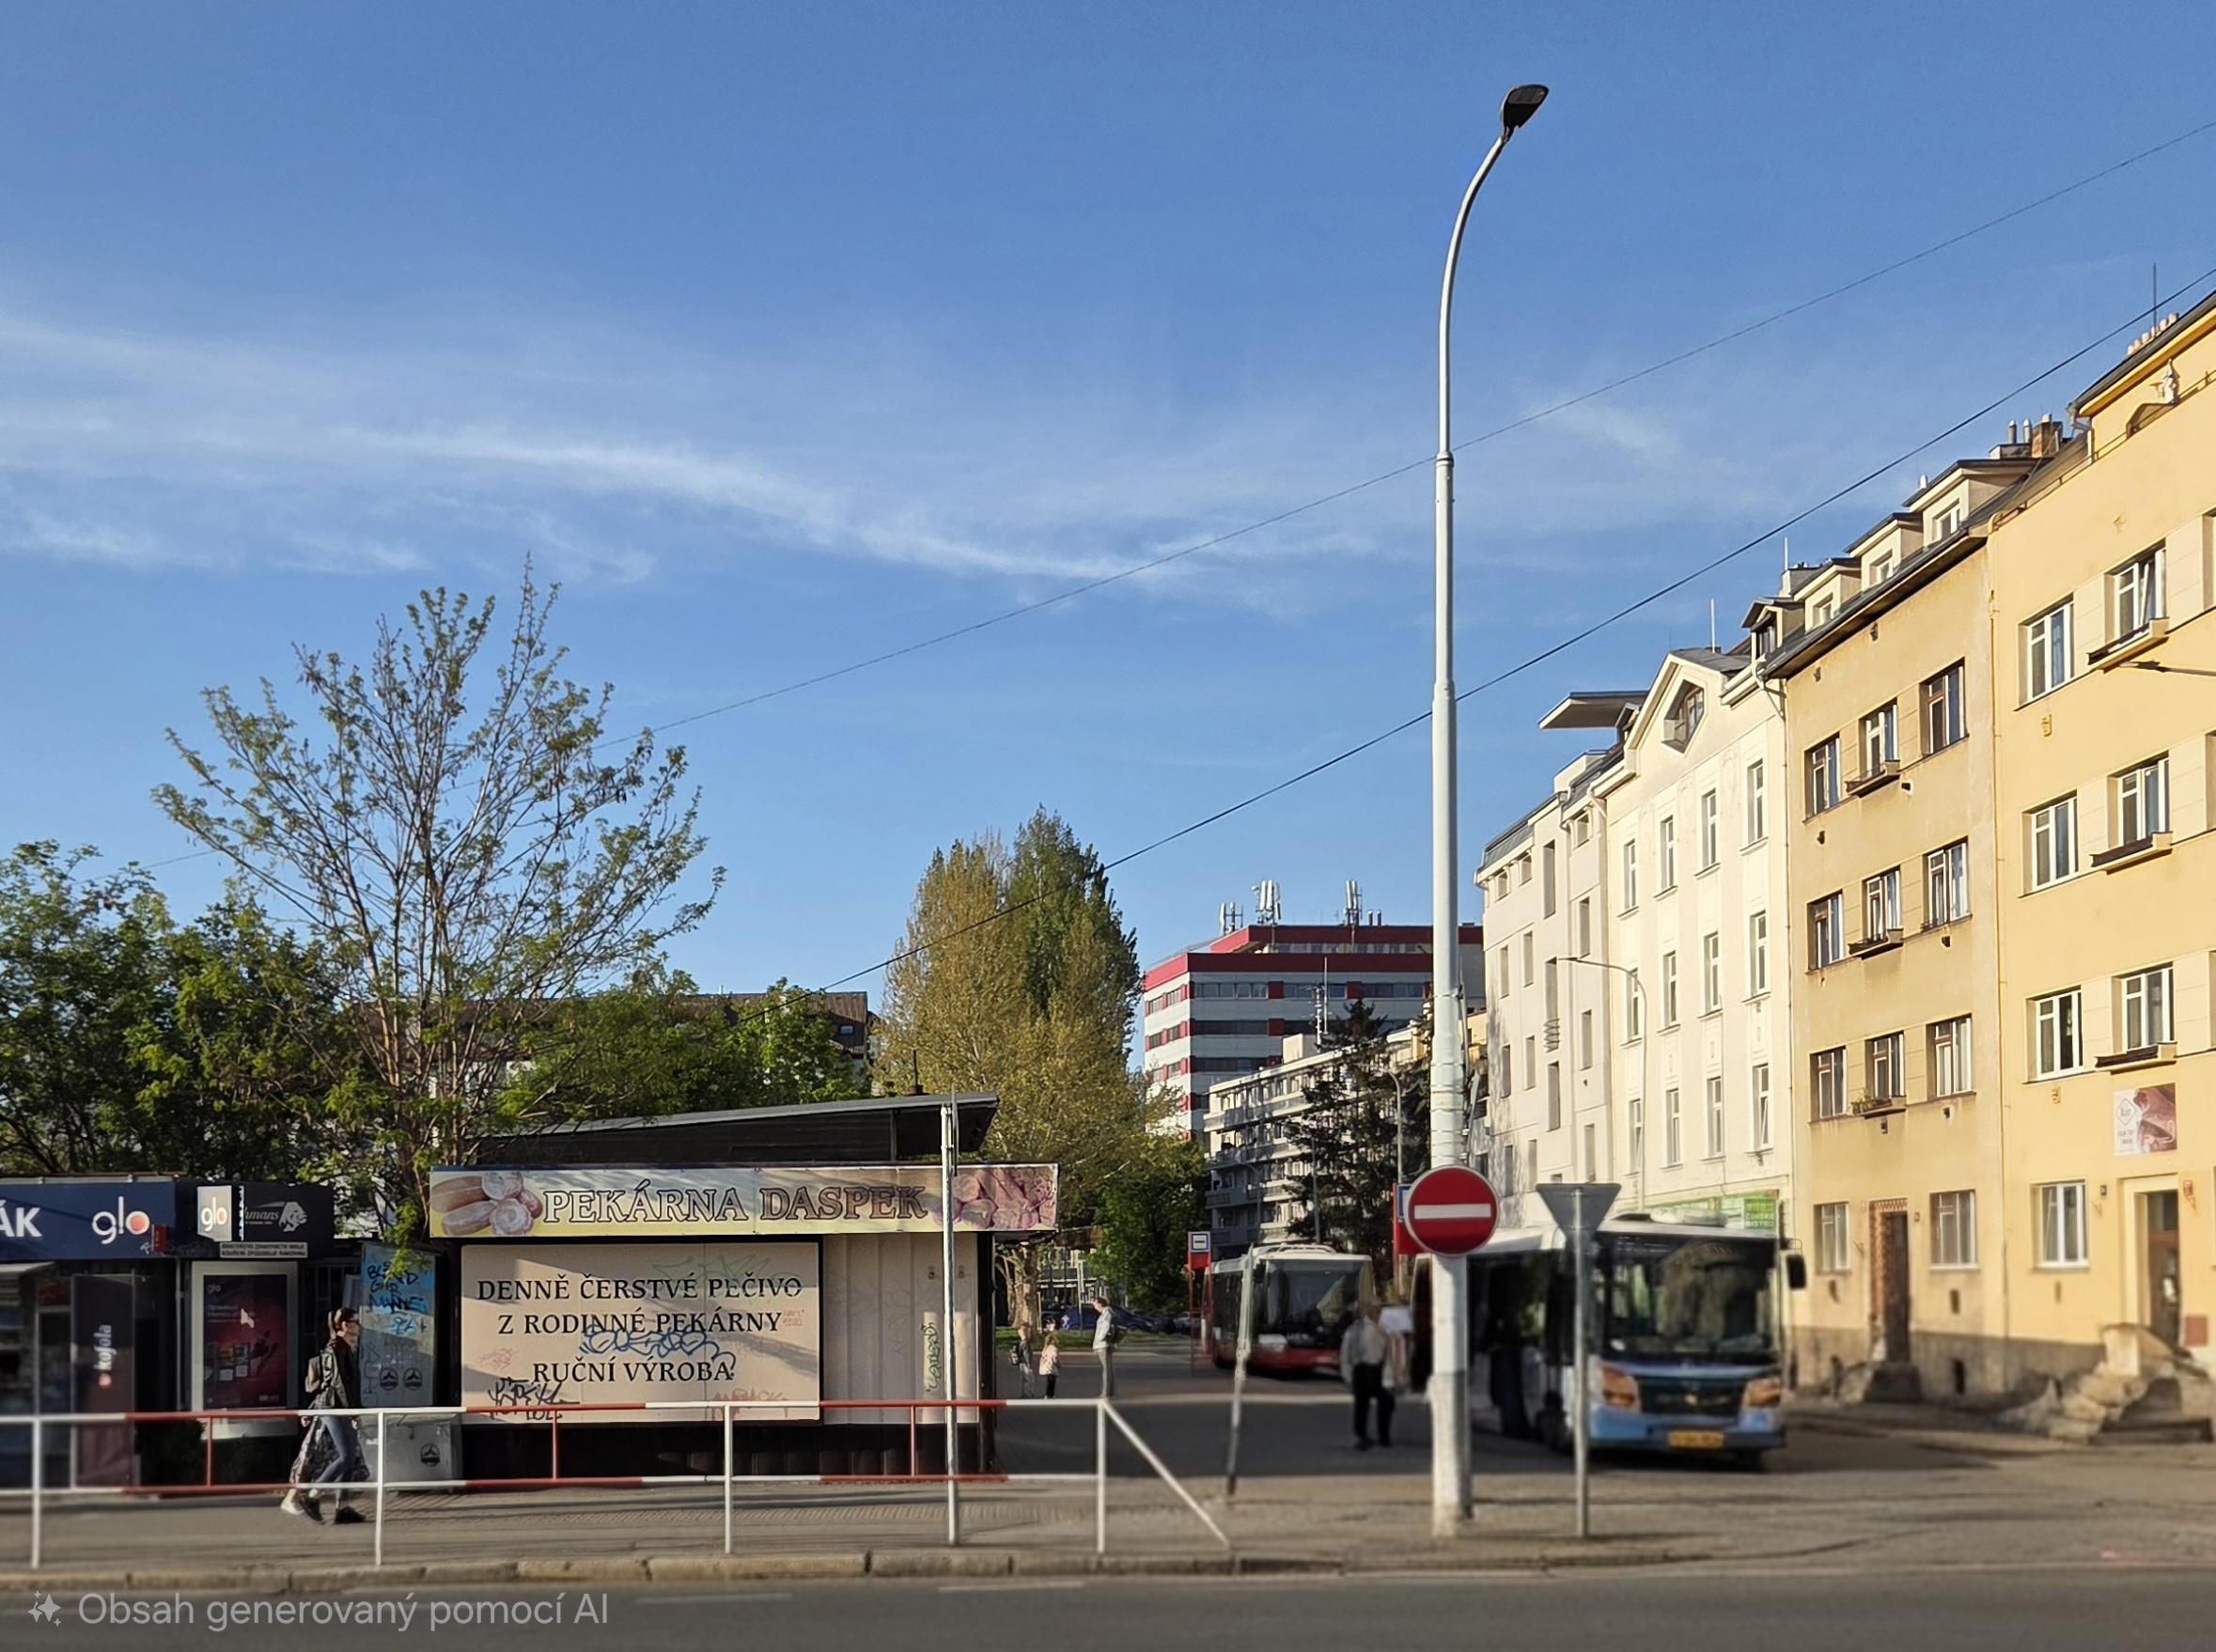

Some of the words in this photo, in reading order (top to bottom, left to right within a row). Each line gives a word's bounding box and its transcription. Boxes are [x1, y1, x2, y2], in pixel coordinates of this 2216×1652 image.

[200, 1196, 228, 1233] glo
[543, 1178, 749, 1223] PEKÁRNA
[759, 1186, 929, 1221] DASPEK
[92, 1195, 150, 1245] glo
[477, 1274, 570, 1301] DENNĚ
[580, 1272, 698, 1299] ČERSTVÉ
[708, 1272, 803, 1298] PEČIVO
[498, 1315, 514, 1334] Z
[524, 1308, 646, 1333] RODINNÉ
[657, 1307, 782, 1333] PEKÁRNY
[93, 1324, 117, 1370] kofola
[533, 1356, 616, 1382] RUČNÍ
[624, 1356, 733, 1382] VÝROBA
